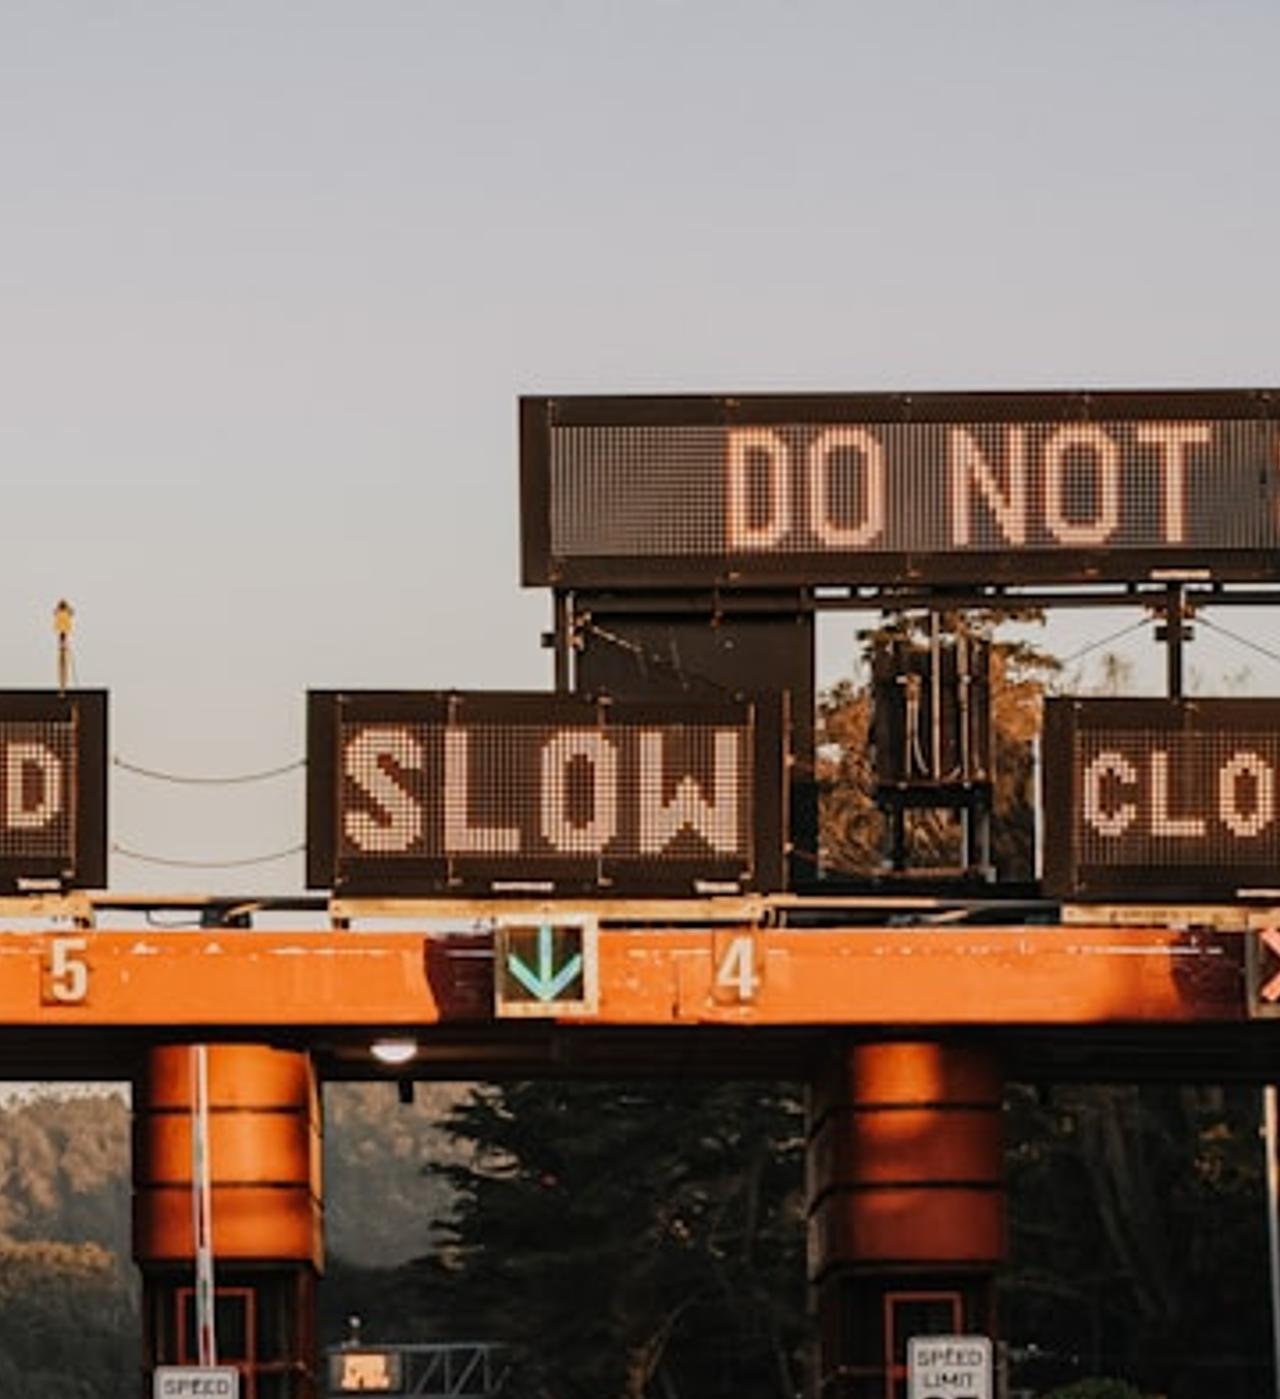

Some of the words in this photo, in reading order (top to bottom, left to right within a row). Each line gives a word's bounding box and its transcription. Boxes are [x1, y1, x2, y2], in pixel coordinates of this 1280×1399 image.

[728, 427, 885, 550] DO
[951, 424, 1210, 546] NOT
[344, 728, 740, 854] SLOW
[51, 939, 88, 1001] 5
[716, 937, 759, 999] 4
[164, 1378, 231, 1396] SPEED
[917, 1350, 984, 1367] SPEED
[923, 1372, 974, 1389] LIMIT
